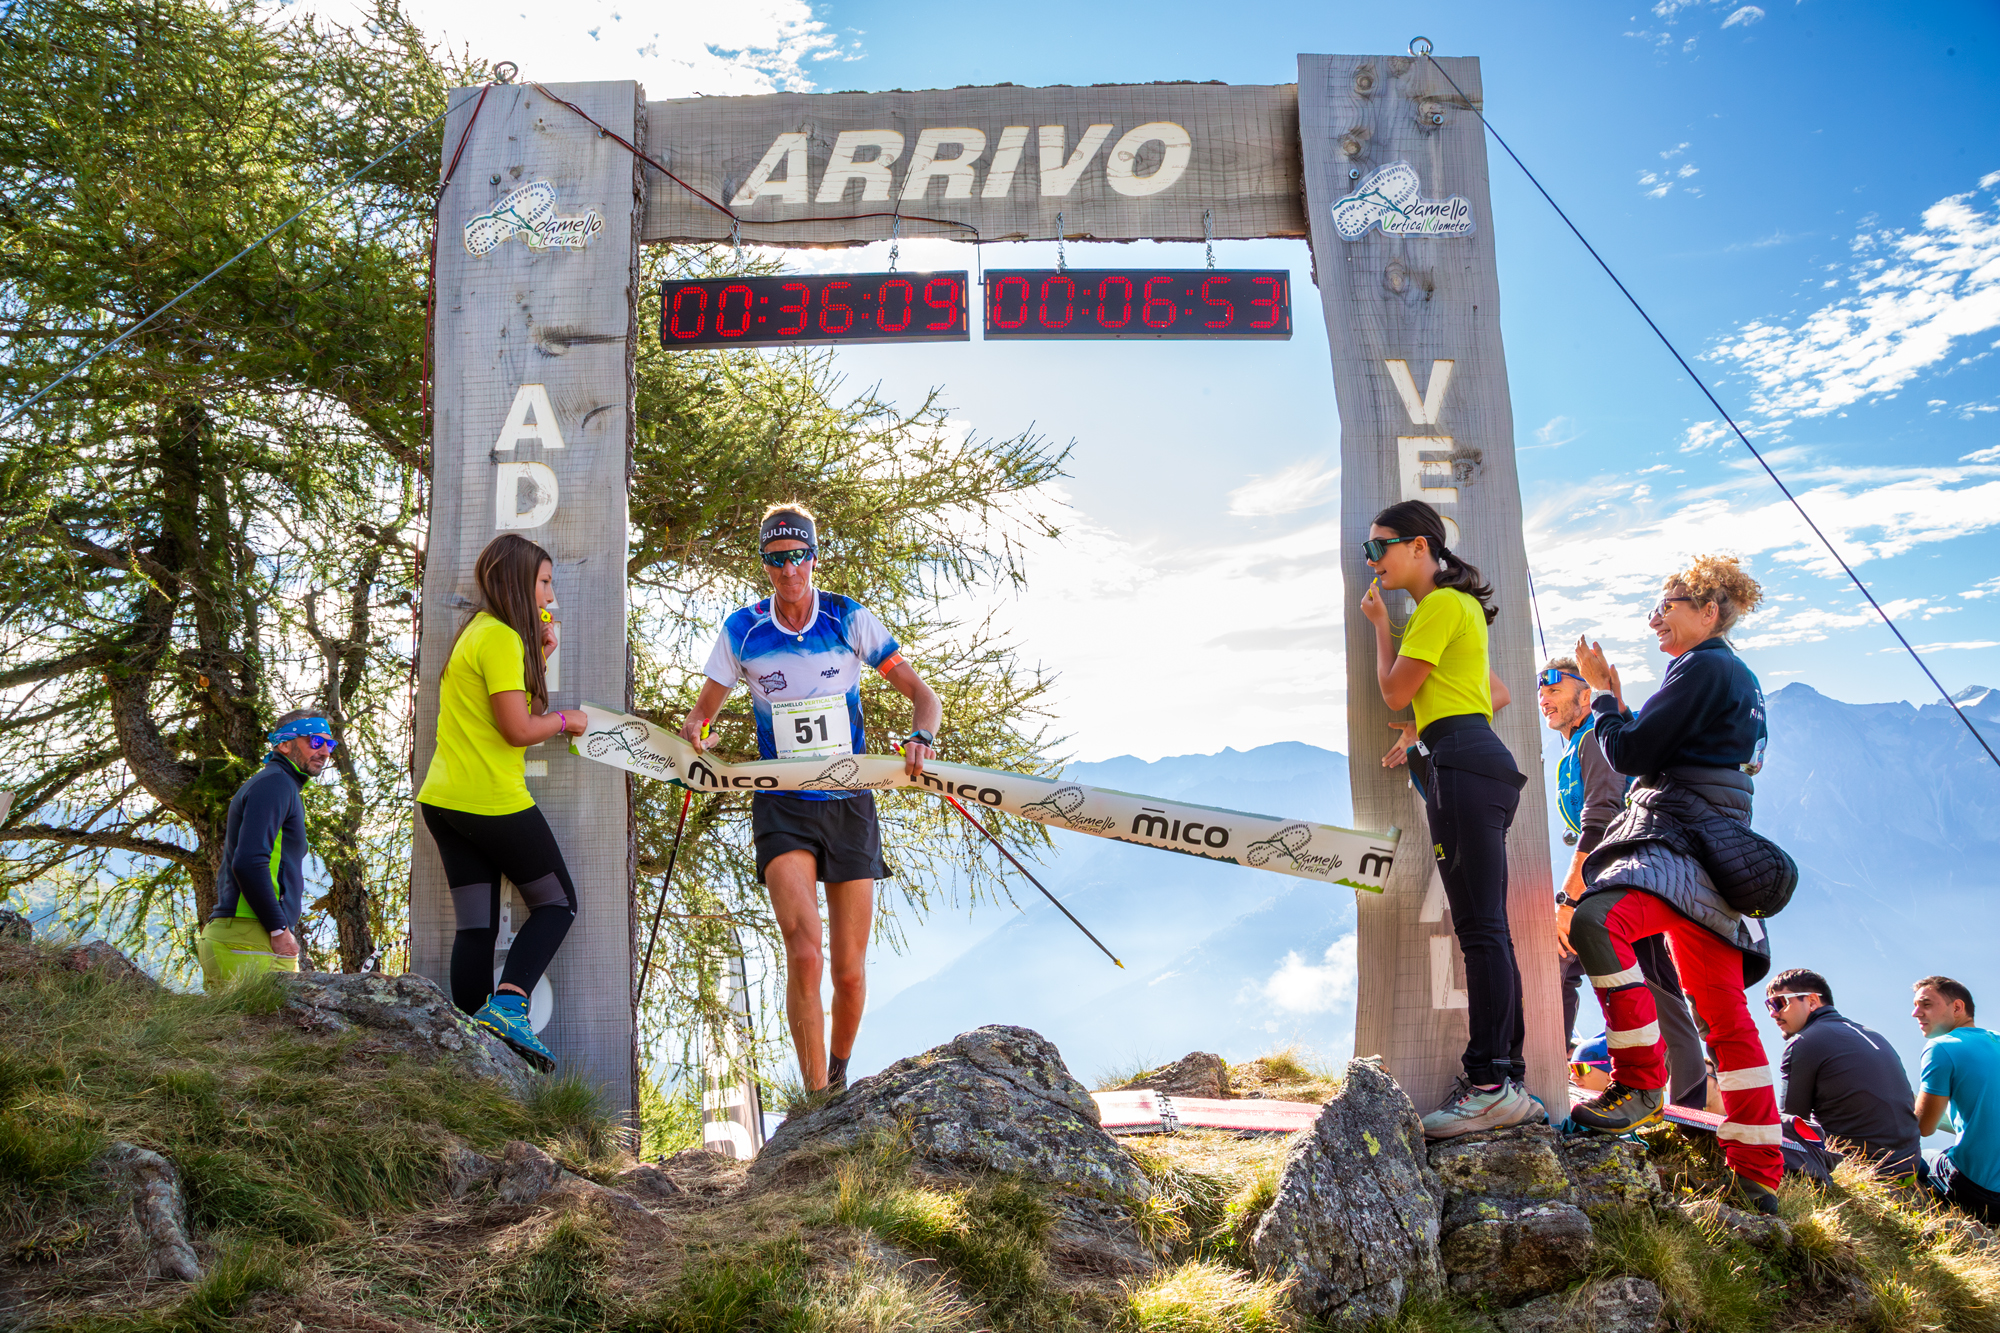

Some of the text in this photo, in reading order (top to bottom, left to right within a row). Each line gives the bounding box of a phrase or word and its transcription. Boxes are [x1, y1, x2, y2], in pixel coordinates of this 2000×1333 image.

[729, 121, 1192, 206] ARRIVO
[670, 278, 959, 339] 00:36:09
[993, 276, 1280, 328] 00:06:53
[762, 527, 809, 543] SUUNTO
[773, 701, 803, 709] ADAMELLO
[804, 697, 831, 706] VERTICAL
[794, 715, 828, 744] 51
